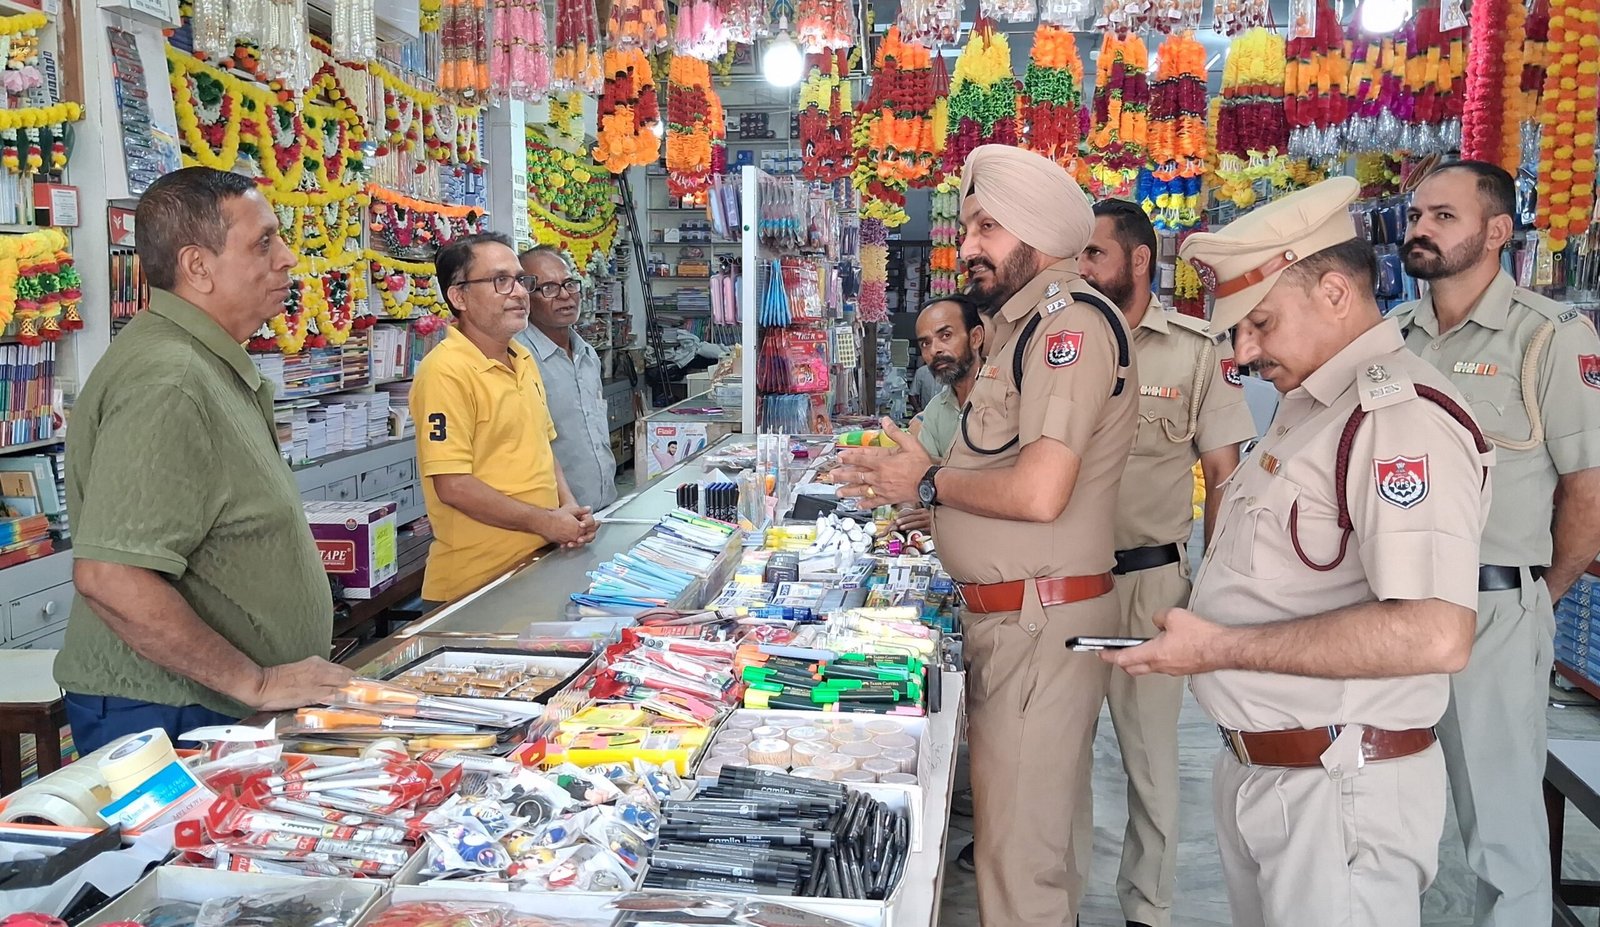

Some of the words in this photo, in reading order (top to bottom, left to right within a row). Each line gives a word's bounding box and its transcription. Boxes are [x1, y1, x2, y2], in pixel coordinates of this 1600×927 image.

[428, 412, 447, 442] 3
[656, 427, 675, 436] Flair
[319, 550, 347, 561] TAPE
